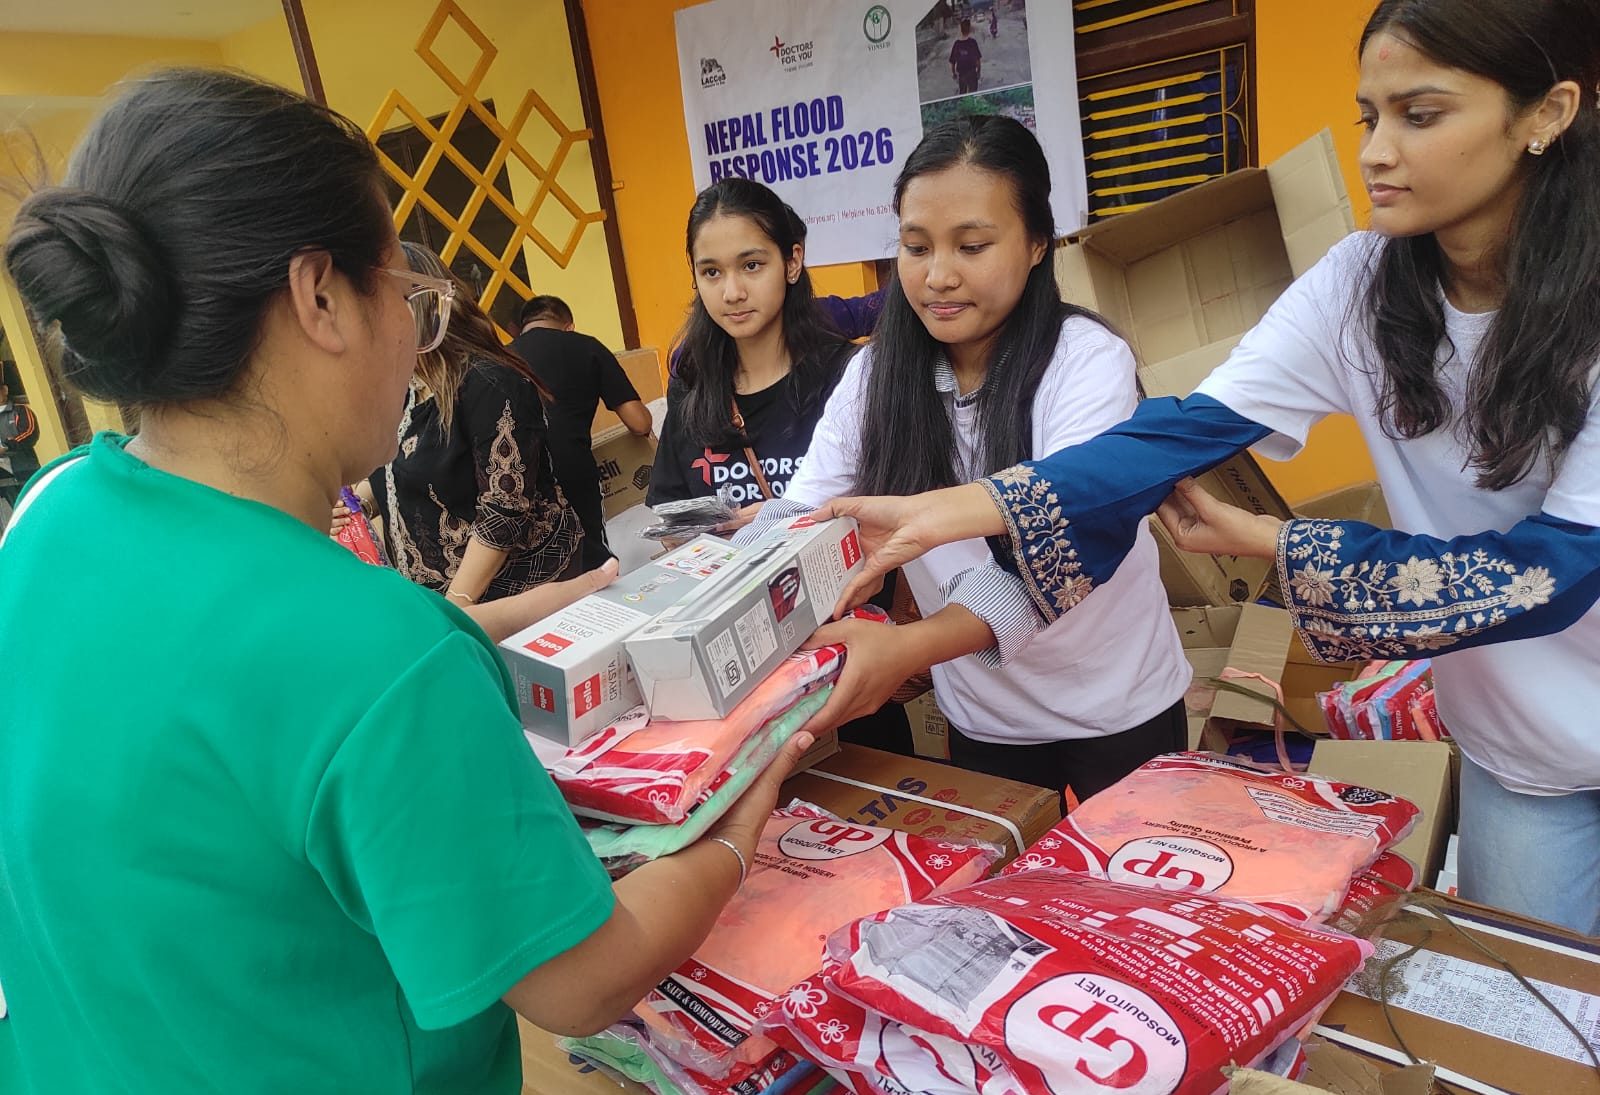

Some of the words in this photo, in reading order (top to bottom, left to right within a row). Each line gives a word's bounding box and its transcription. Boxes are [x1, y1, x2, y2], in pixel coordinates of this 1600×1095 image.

[781, 41, 813, 56] DOCTORS
[781, 55, 797, 64] FOR
[798, 50, 812, 61] YOU
[704, 114, 768, 155] NEPAL
[771, 95, 843, 137] FLOOD
[709, 145, 821, 184] RESPONSE
[824, 128, 894, 173] 2026
[1247, 496, 1267, 514] SID
[845, 536, 855, 564] cello
[556, 621, 593, 638] CRYSTA
[536, 637, 563, 652] cello
[607, 659, 617, 701] CRYSTA
[539, 687, 547, 709] cello
[583, 680, 592, 710] cello
[1141, 821, 1180, 833] HOSIERY
[1167, 820, 1202, 832] Quality
[783, 837, 827, 850] MOSQUITO
[825, 847, 846, 855] NET
[1144, 839, 1168, 847] NET
[1205, 829, 1252, 844] Premium
[1212, 837, 1258, 851] PRODUCT
[1169, 844, 1225, 863] MOSQUITO
[1124, 850, 1206, 890] GP
[1350, 880, 1380, 896] Avail
[1041, 904, 1079, 919] GREEN
[1049, 898, 1093, 913] PURPLE
[1060, 929, 1079, 940] Soft
[1129, 931, 1164, 945] BLUE
[1135, 922, 1175, 940] WHITE
[1196, 919, 1242, 938] Various
[1301, 931, 1343, 944] QUAL
[1080, 939, 1106, 956] Extra
[1095, 938, 1106, 946] to
[1120, 942, 1131, 951] in
[1232, 942, 1260, 961] taxes)
[1246, 938, 1260, 947] in
[1107, 944, 1148, 972] bedroom
[1127, 940, 1181, 970] Vario
[1131, 948, 1156, 967] bites
[1235, 953, 1273, 976] Retail
[1261, 960, 1274, 968] all
[1261, 945, 1316, 984] Available
[1106, 954, 1148, 979] Stitched
[1184, 967, 1200, 980] in
[1210, 954, 1264, 988] ORANGE
[1149, 969, 1172, 984] your
[1156, 964, 1202, 994] mosquito
[1217, 974, 1253, 997] PINK
[1073, 977, 1106, 999] NET
[1276, 975, 1297, 1002] Max.
[1174, 983, 1222, 1019] transform
[1202, 993, 1214, 1004] of
[1202, 979, 1260, 1037] Available
[663, 982, 686, 1000] SAFE
[682, 995, 691, 1005] &
[688, 1000, 742, 1041] COMFORTABLE
[1216, 1001, 1239, 1019] pain
[1106, 993, 1181, 1047] MOSQUITO
[1189, 1002, 1231, 1043] Specially
[1223, 1017, 1240, 1047] Truly
[1237, 1021, 1248, 1040] the
[1038, 1001, 1148, 1089] GP
